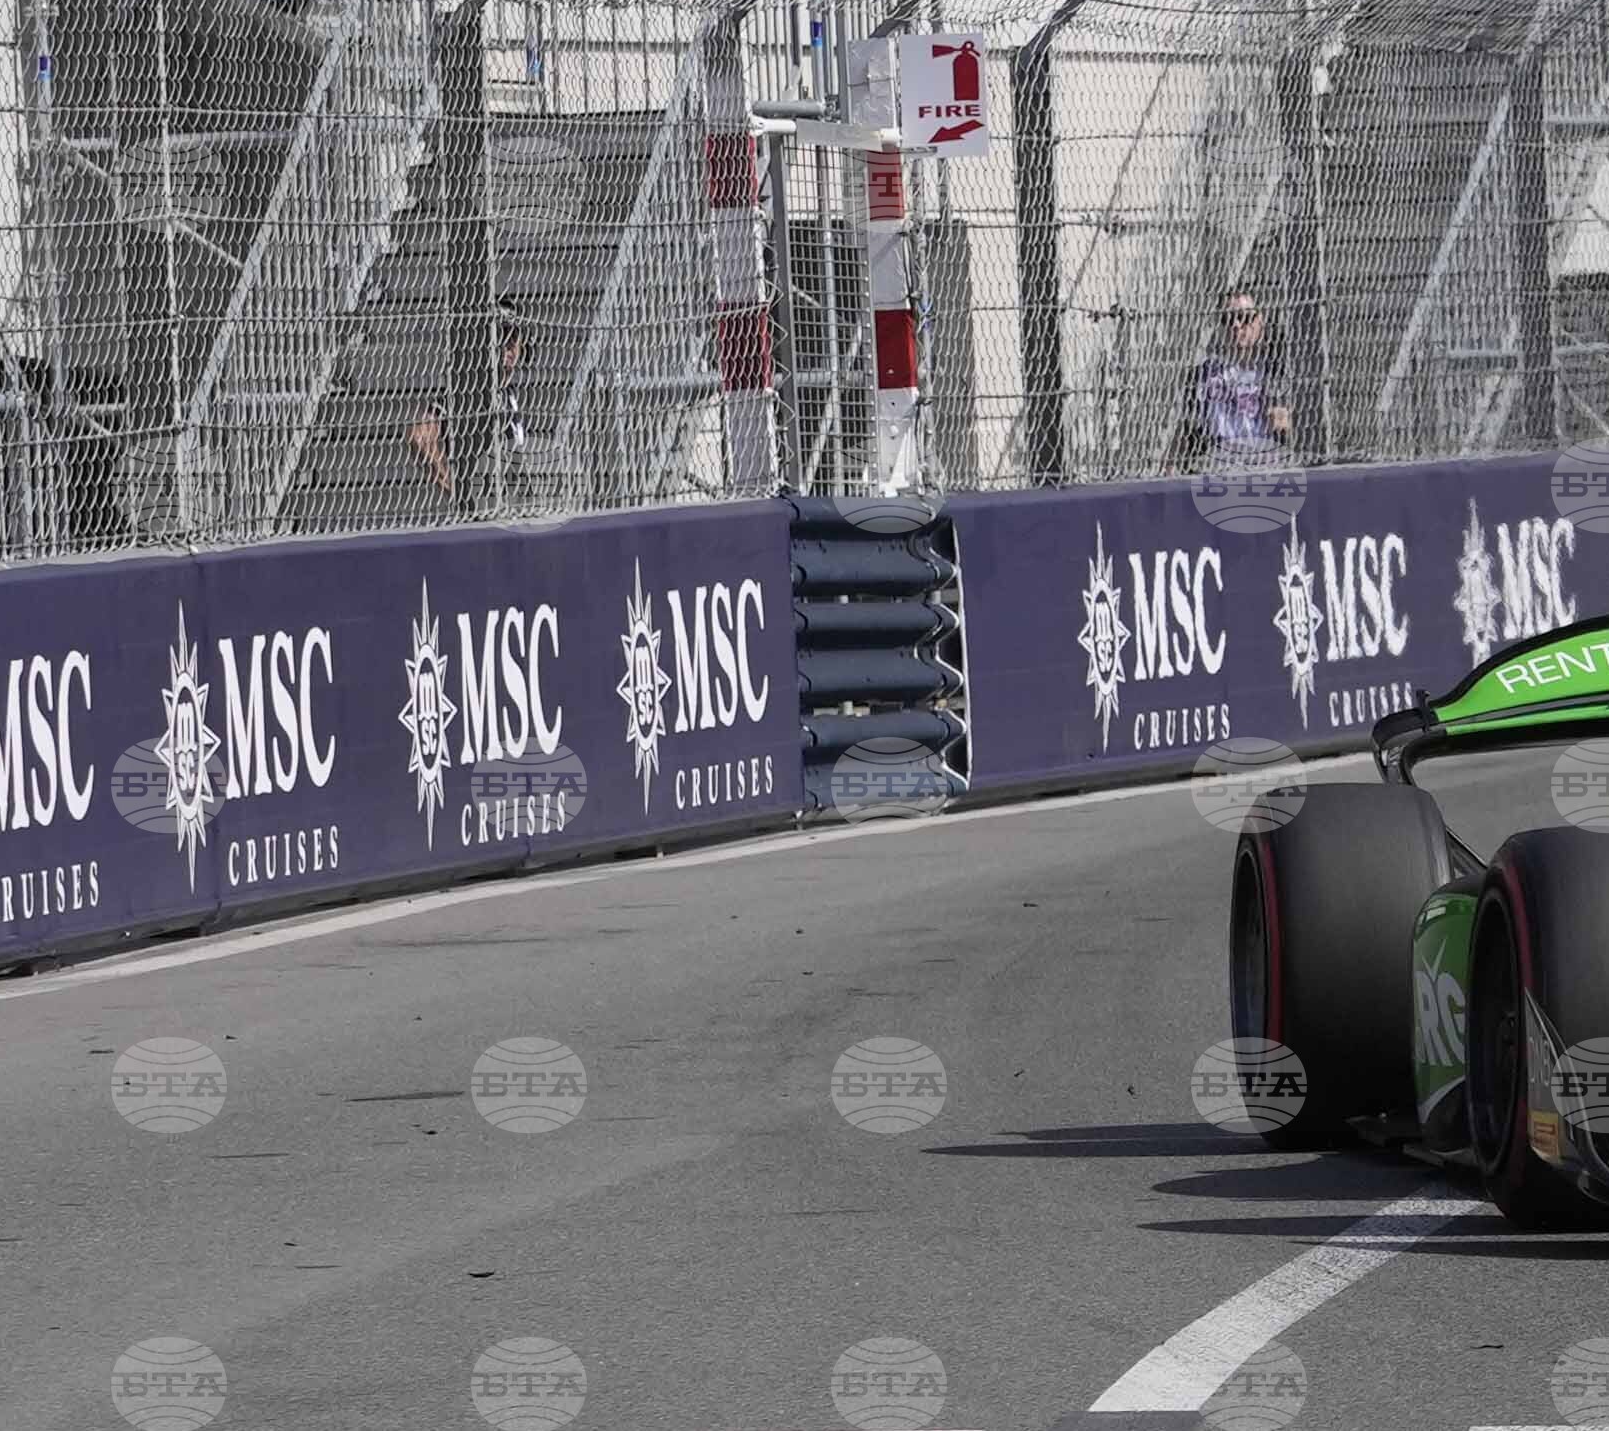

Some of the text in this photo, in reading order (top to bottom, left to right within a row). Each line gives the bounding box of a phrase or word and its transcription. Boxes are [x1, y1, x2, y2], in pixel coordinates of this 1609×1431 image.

[917, 104, 982, 119] FIRE
[1128, 547, 1226, 681] MSC
[1320, 533, 1410, 662] MSC
[456, 604, 563, 766] MSC
[667, 578, 769, 733] MSC
[218, 626, 336, 800] MSC
[1134, 703, 1231, 751] CRUISES
[461, 791, 566, 846] CRUISES
[675, 755, 774, 810] CRUISES
[228, 825, 339, 886] CRUISES
